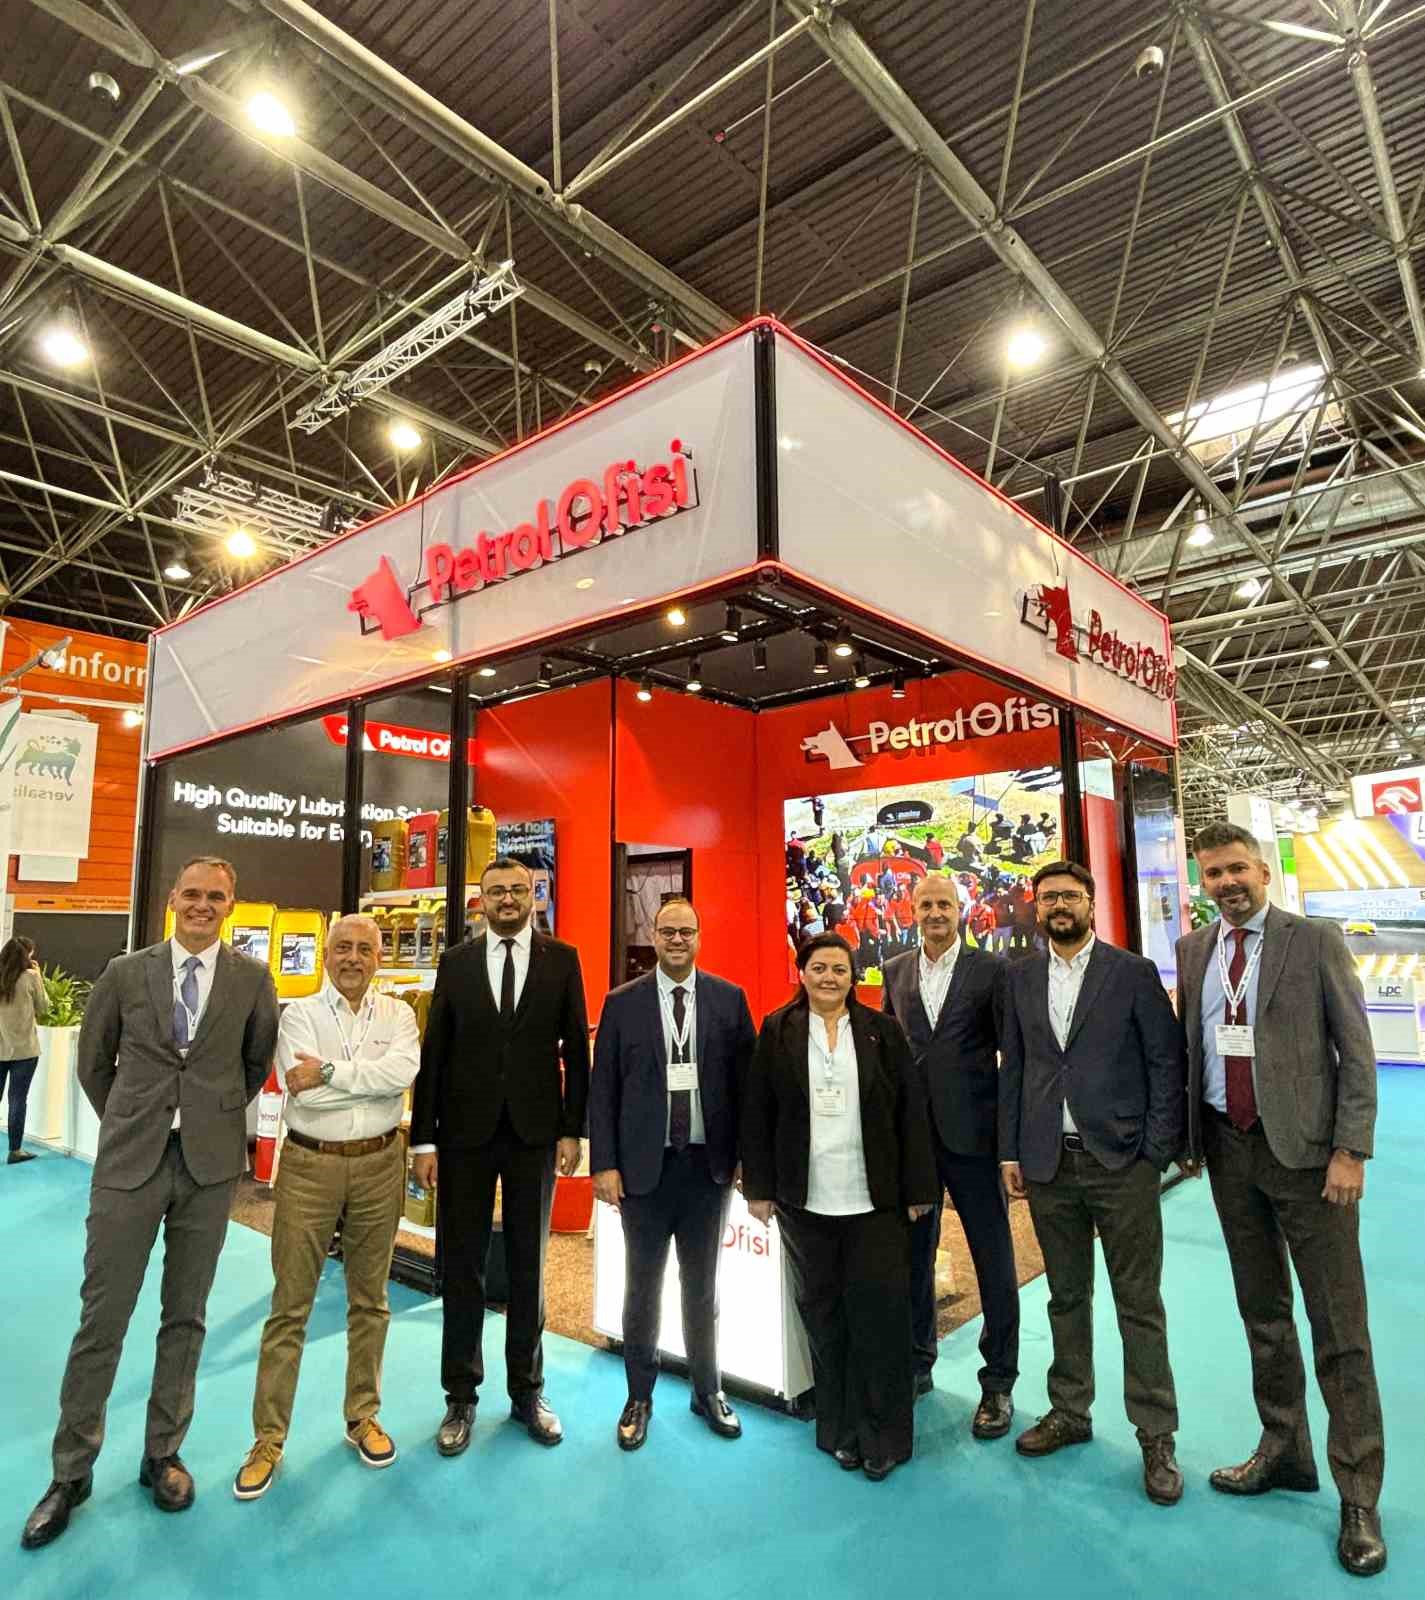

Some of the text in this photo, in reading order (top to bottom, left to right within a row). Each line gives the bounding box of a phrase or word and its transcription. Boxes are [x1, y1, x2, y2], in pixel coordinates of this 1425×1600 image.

[425, 438, 689, 603] Petrol Ofisi
[1088, 608, 1141, 680] Petrol
[379, 729, 428, 755] Petrol
[868, 696, 1060, 754] Petrol Ofisi
[173, 780, 222, 809] High
[225, 787, 297, 817] Quality
[299, 795, 394, 821] Lubrition
[216, 813, 295, 839] Suitable
[299, 820, 326, 841] for
